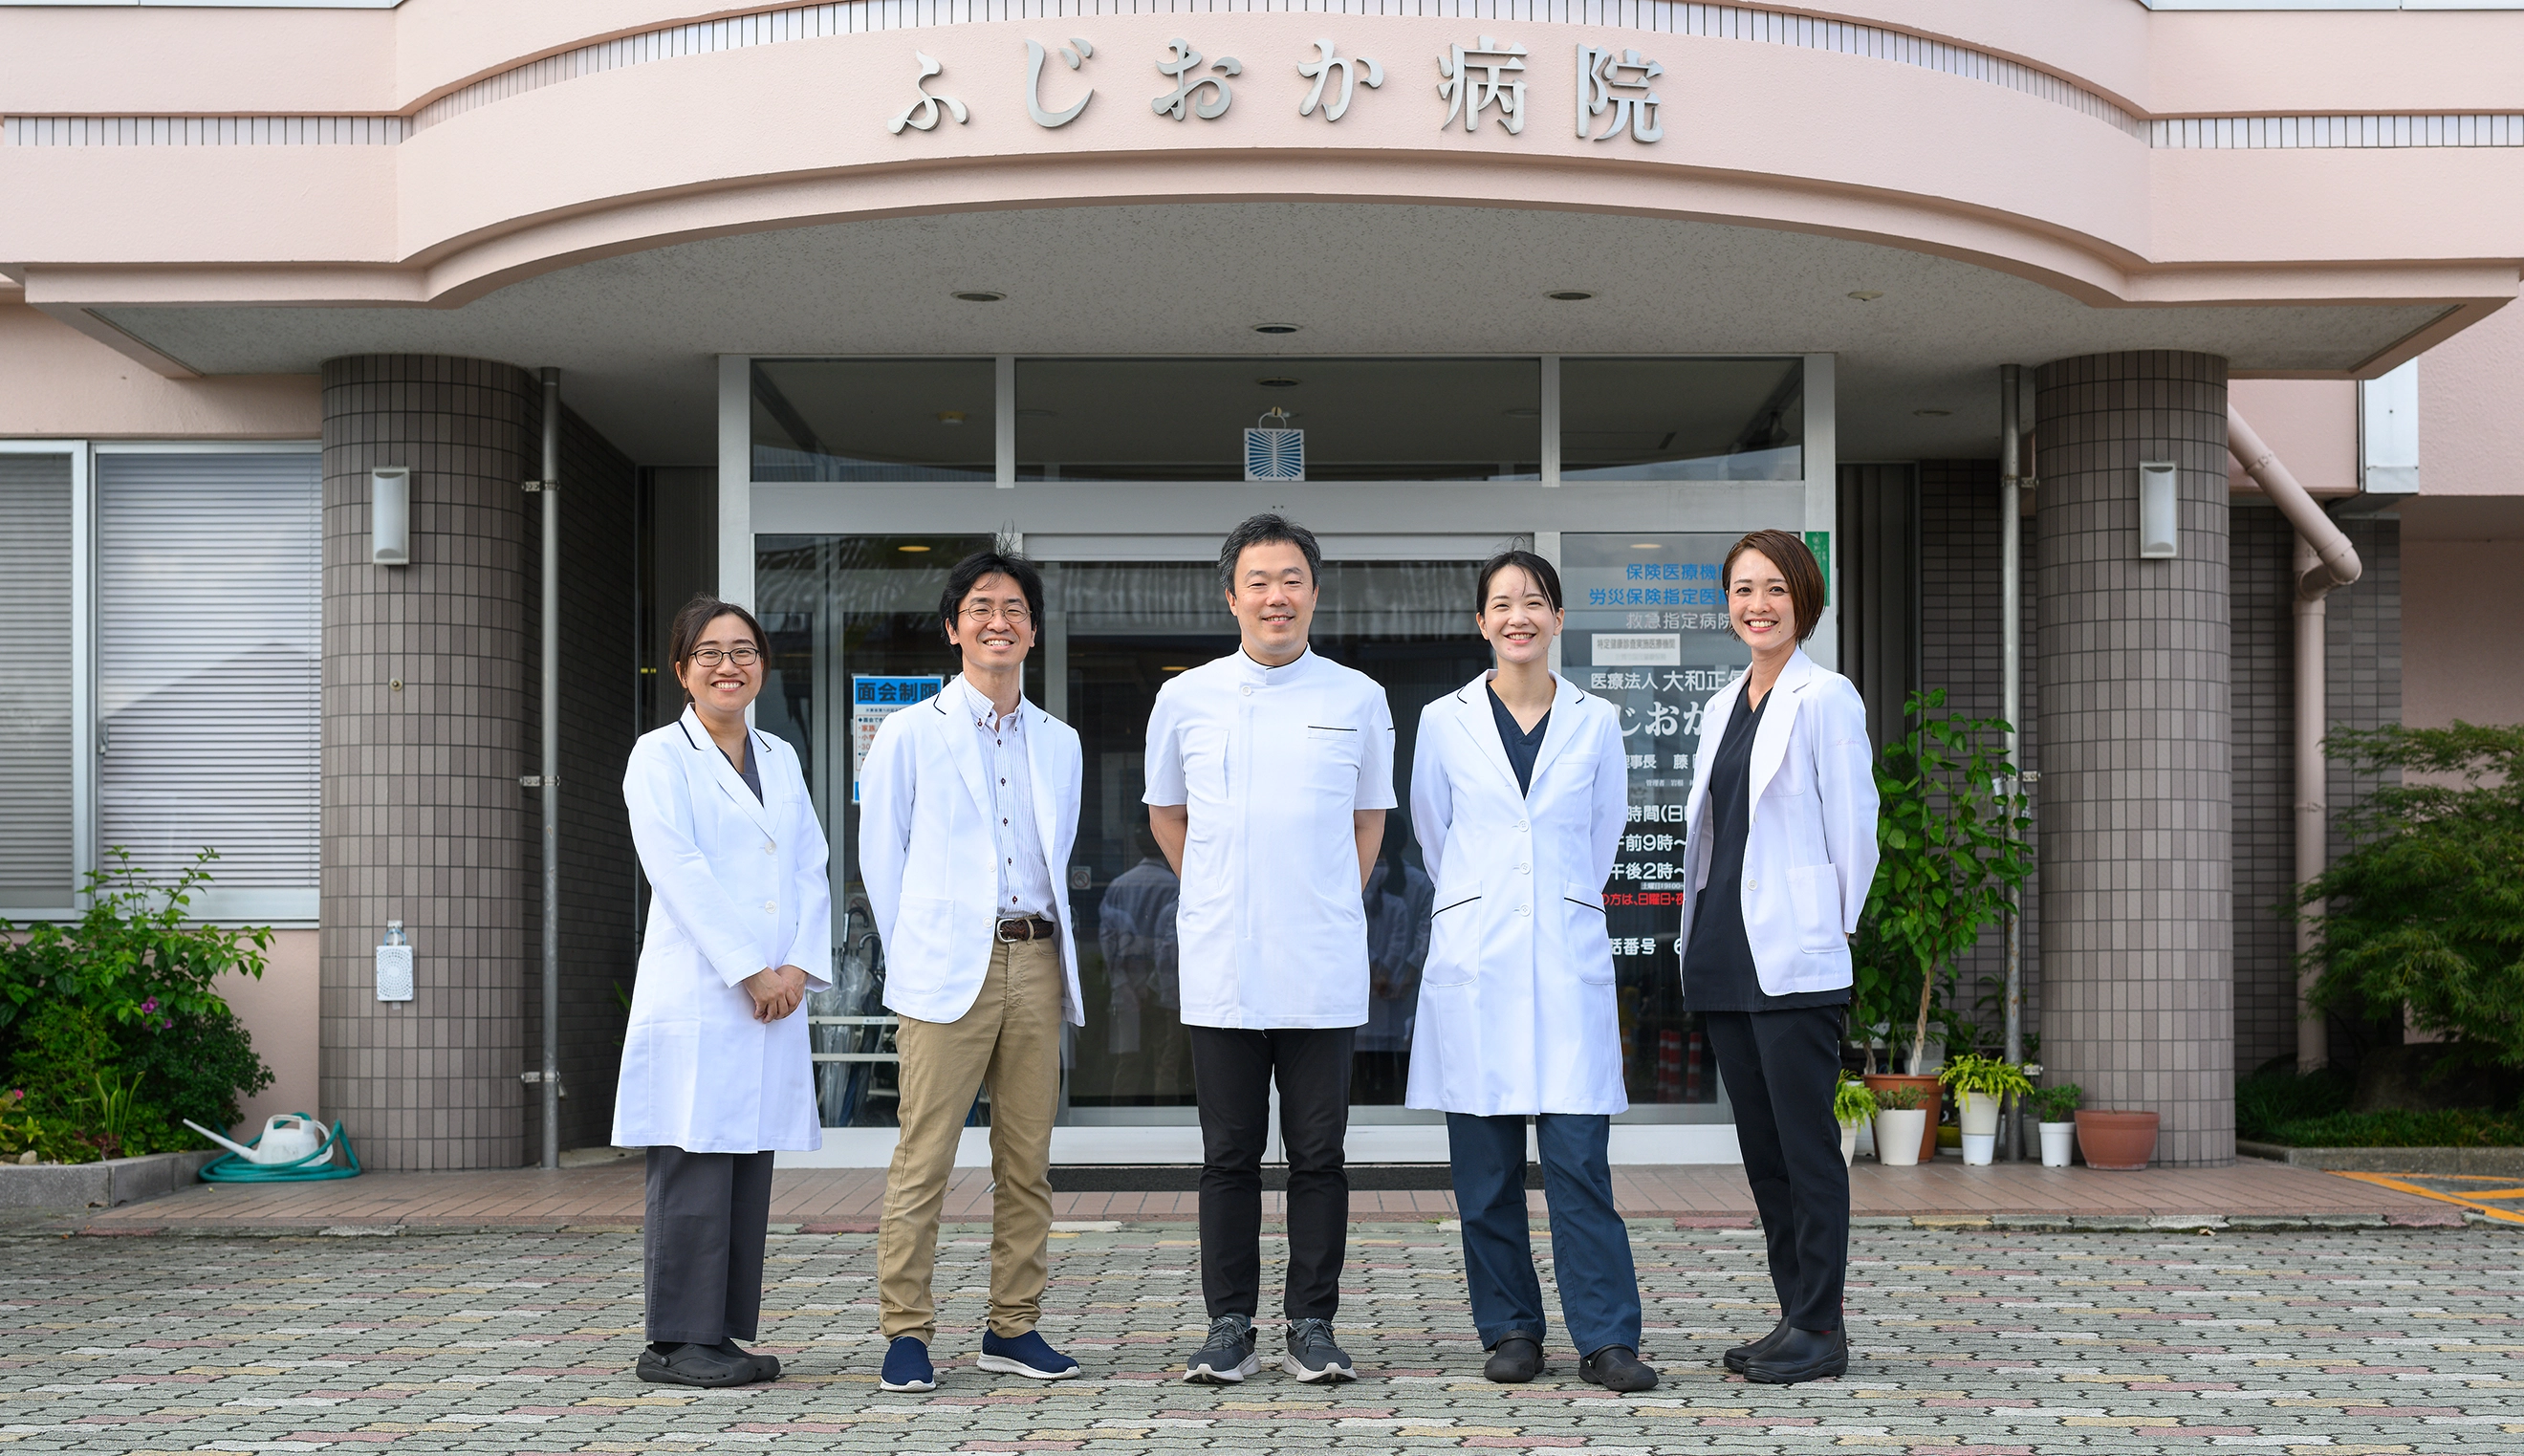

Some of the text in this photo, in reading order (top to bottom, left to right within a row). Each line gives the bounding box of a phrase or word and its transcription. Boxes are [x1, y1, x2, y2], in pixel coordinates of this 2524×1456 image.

[887, 34, 1665, 143] ふじおか病院
[1626, 563, 1722, 580] 保険医療機
[1626, 612, 1731, 629] 救急指定病院
[1591, 672, 1658, 690] 医療法人
[857, 682, 939, 702] 面会制限
[1627, 804, 1687, 822] 時間(日
